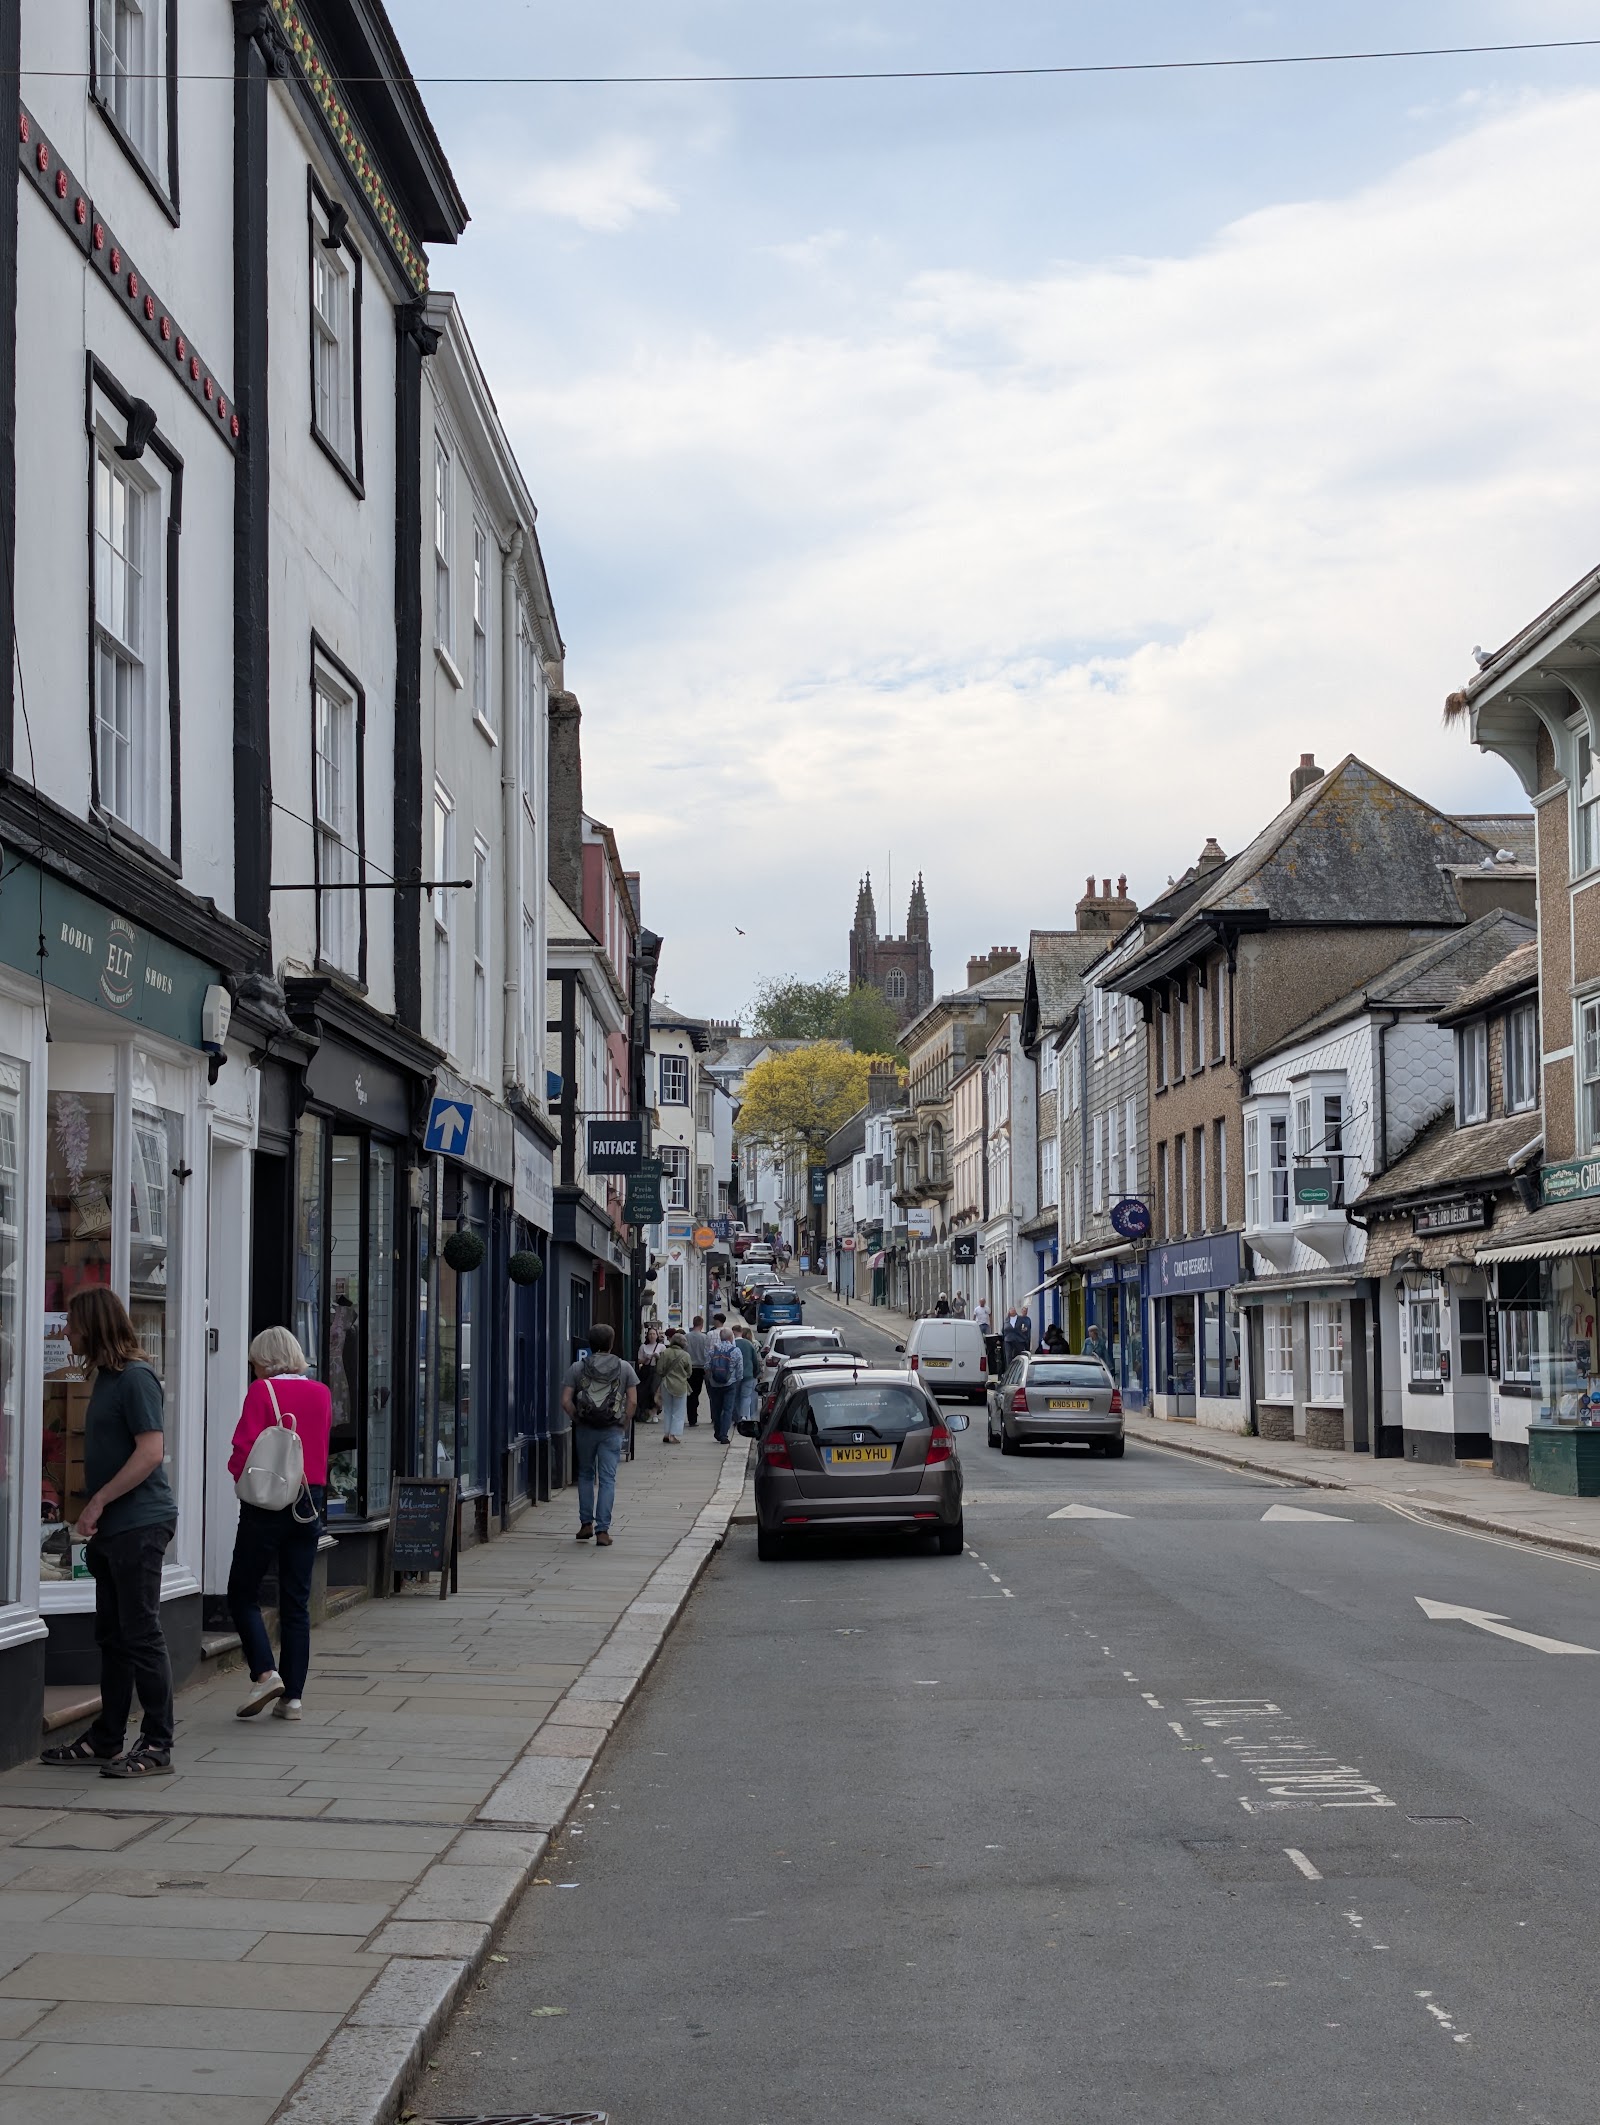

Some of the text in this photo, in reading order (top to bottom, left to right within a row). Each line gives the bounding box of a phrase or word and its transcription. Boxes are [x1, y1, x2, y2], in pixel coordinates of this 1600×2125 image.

[60, 922, 95, 955] ROBIN
[106, 943, 134, 979] ELT
[144, 966, 174, 996] SHOES
[592, 1140, 637, 1155] FATFACE
[1428, 1212, 1438, 1227] THE
[1438, 1210, 1451, 1225] LORD
[1450, 1206, 1469, 1223] NELSON
[1173, 1260, 1189, 1277] CANCER
[1188, 1257, 1208, 1275] RESEARCH
[836, 1448, 888, 1460] WV13 YHU
[401, 1487, 437, 1496] We Need
